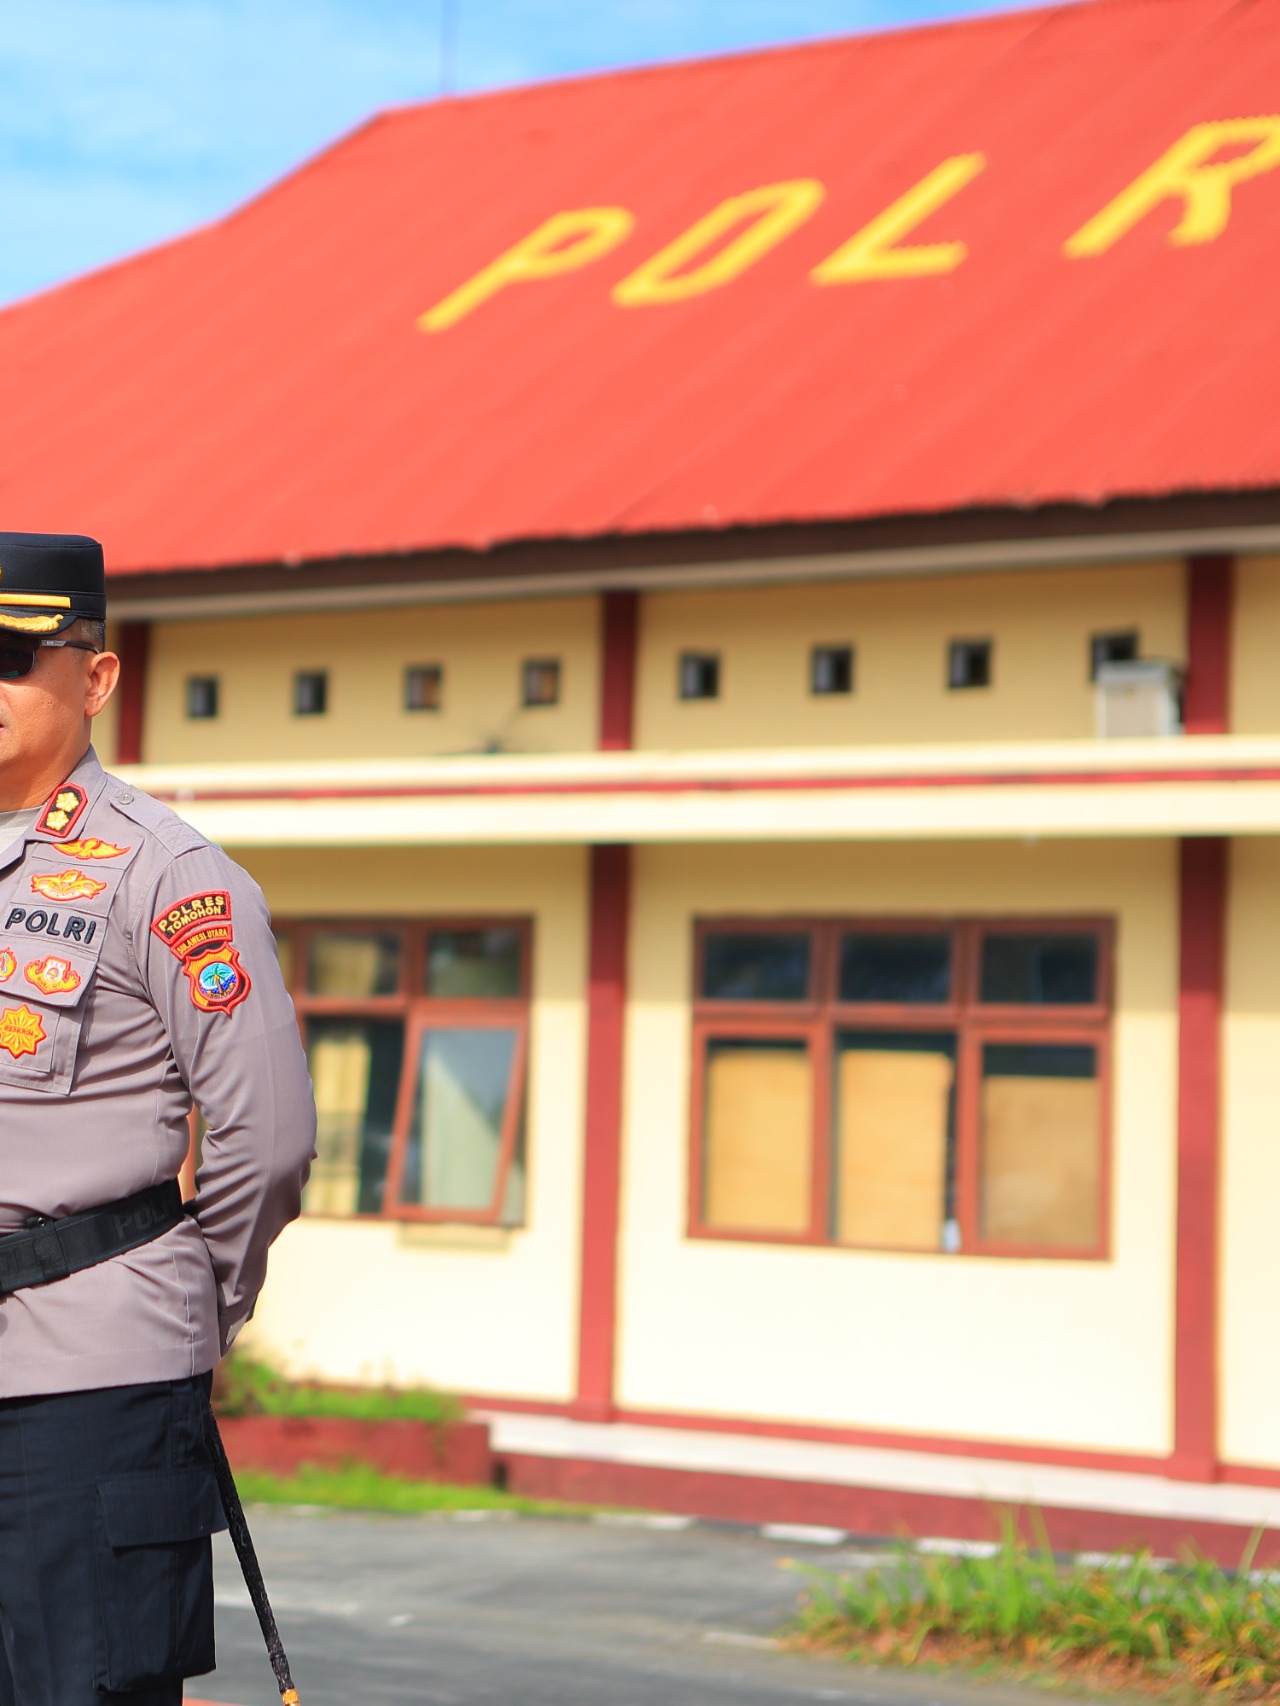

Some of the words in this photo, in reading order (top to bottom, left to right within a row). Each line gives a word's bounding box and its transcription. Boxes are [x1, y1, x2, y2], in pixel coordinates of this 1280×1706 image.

[4, 907, 97, 945] POLRI
[158, 896, 224, 932] POLRES
[167, 905, 222, 934] TOMOHON
[177, 931, 206, 954] SULAWESI
[207, 928, 228, 939] UTARA
